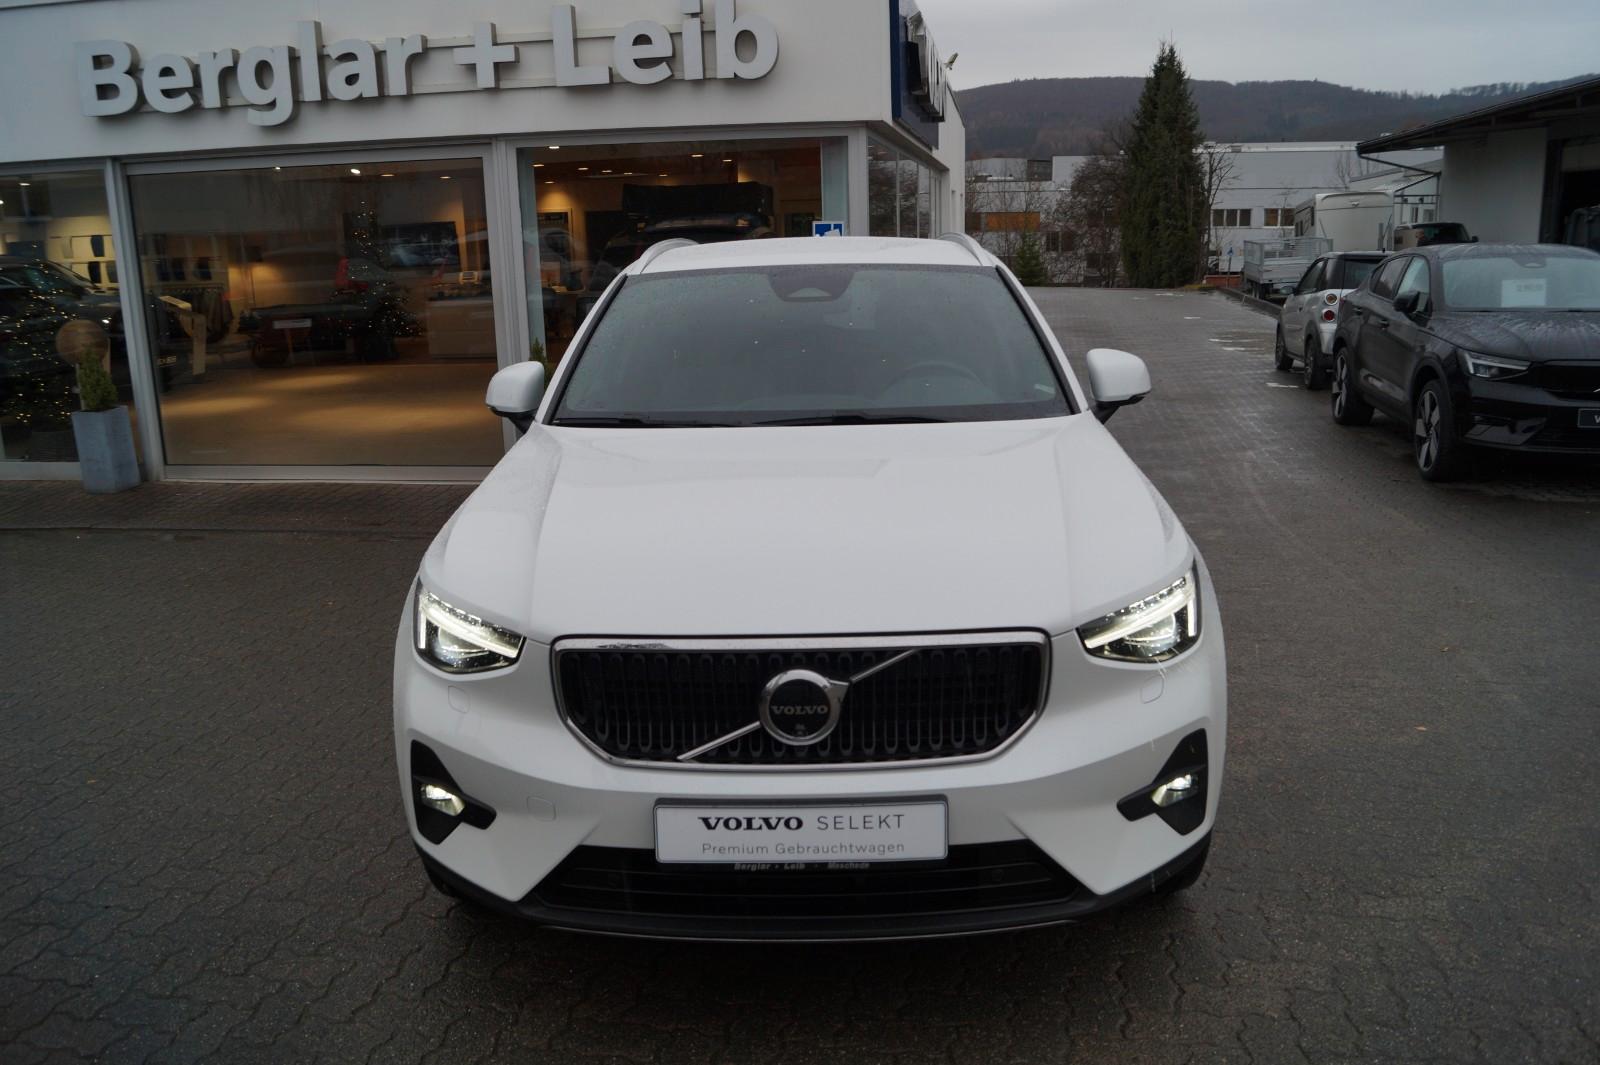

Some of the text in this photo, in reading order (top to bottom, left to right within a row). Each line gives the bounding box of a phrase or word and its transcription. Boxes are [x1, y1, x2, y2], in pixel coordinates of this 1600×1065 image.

[73, 0, 779, 126] Berglar + Leib
[771, 705, 828, 715] VOLVO
[697, 814, 905, 830] VOLVO SELEKT
[702, 842, 905, 856] Premium Gebrauchtwagen
